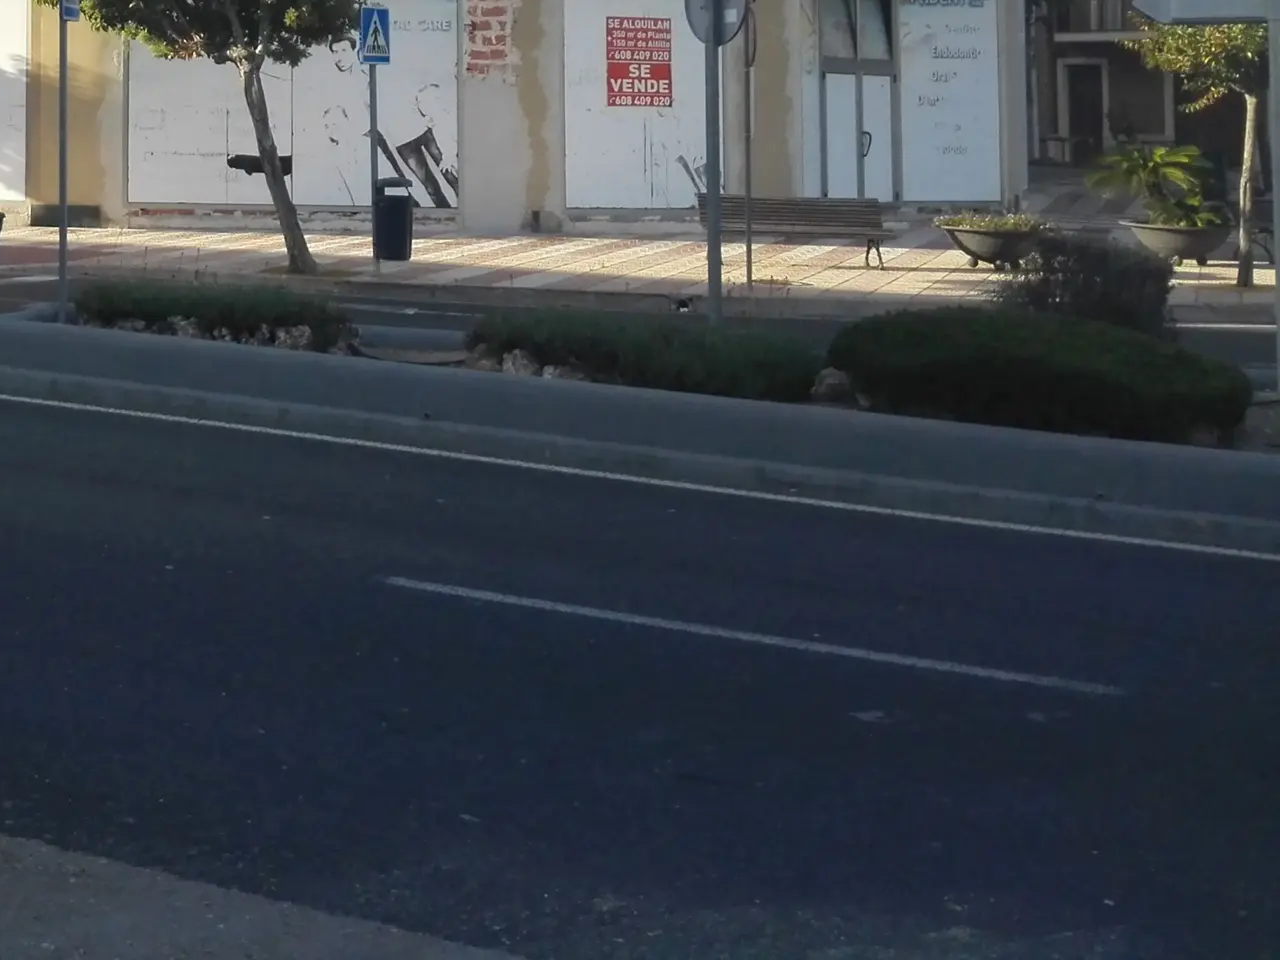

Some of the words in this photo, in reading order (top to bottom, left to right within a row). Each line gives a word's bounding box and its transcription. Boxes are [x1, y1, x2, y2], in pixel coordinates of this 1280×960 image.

[608, 18, 620, 28] SE
[622, 20, 670, 29] ALQUILAN
[612, 30, 626, 38] 350
[637, 31, 646, 39] de
[648, 31, 671, 39] Planta
[613, 39, 626, 47] 150
[648, 39, 670, 47] Altillo
[614, 50, 631, 60] 608
[633, 51, 651, 60] 409
[652, 52, 669, 60] 020
[629, 64, 651, 78] SE
[610, 79, 670, 93] VENDE
[615, 96, 632, 105] 608
[634, 96, 651, 105] 409
[653, 96, 670, 106] 020
